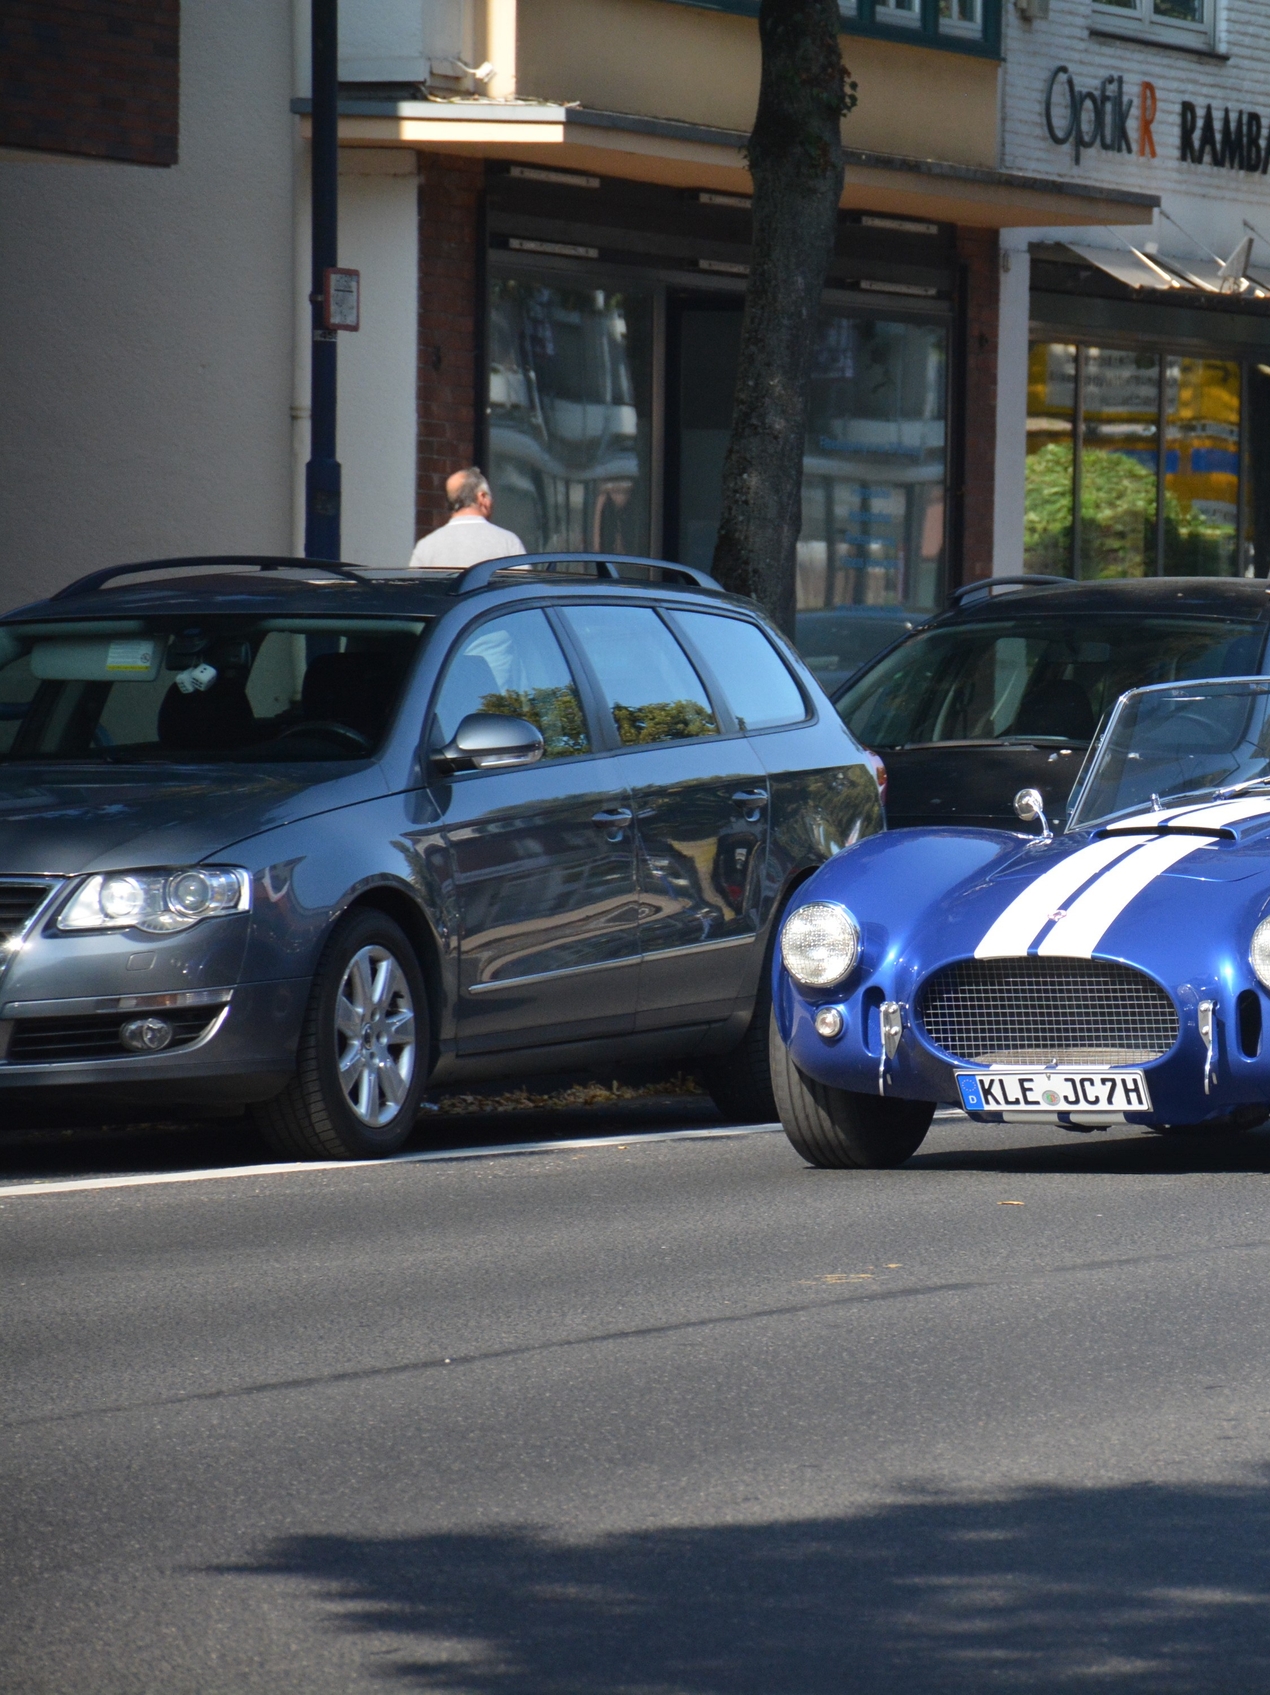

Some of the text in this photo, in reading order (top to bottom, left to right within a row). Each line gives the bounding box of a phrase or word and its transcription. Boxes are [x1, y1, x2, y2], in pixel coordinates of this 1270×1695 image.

[1045, 65, 1133, 166] Optik
[1139, 80, 1157, 159] R
[968, 1095, 977, 1104] D
[978, 1078, 1144, 1106] KLE JC7H
